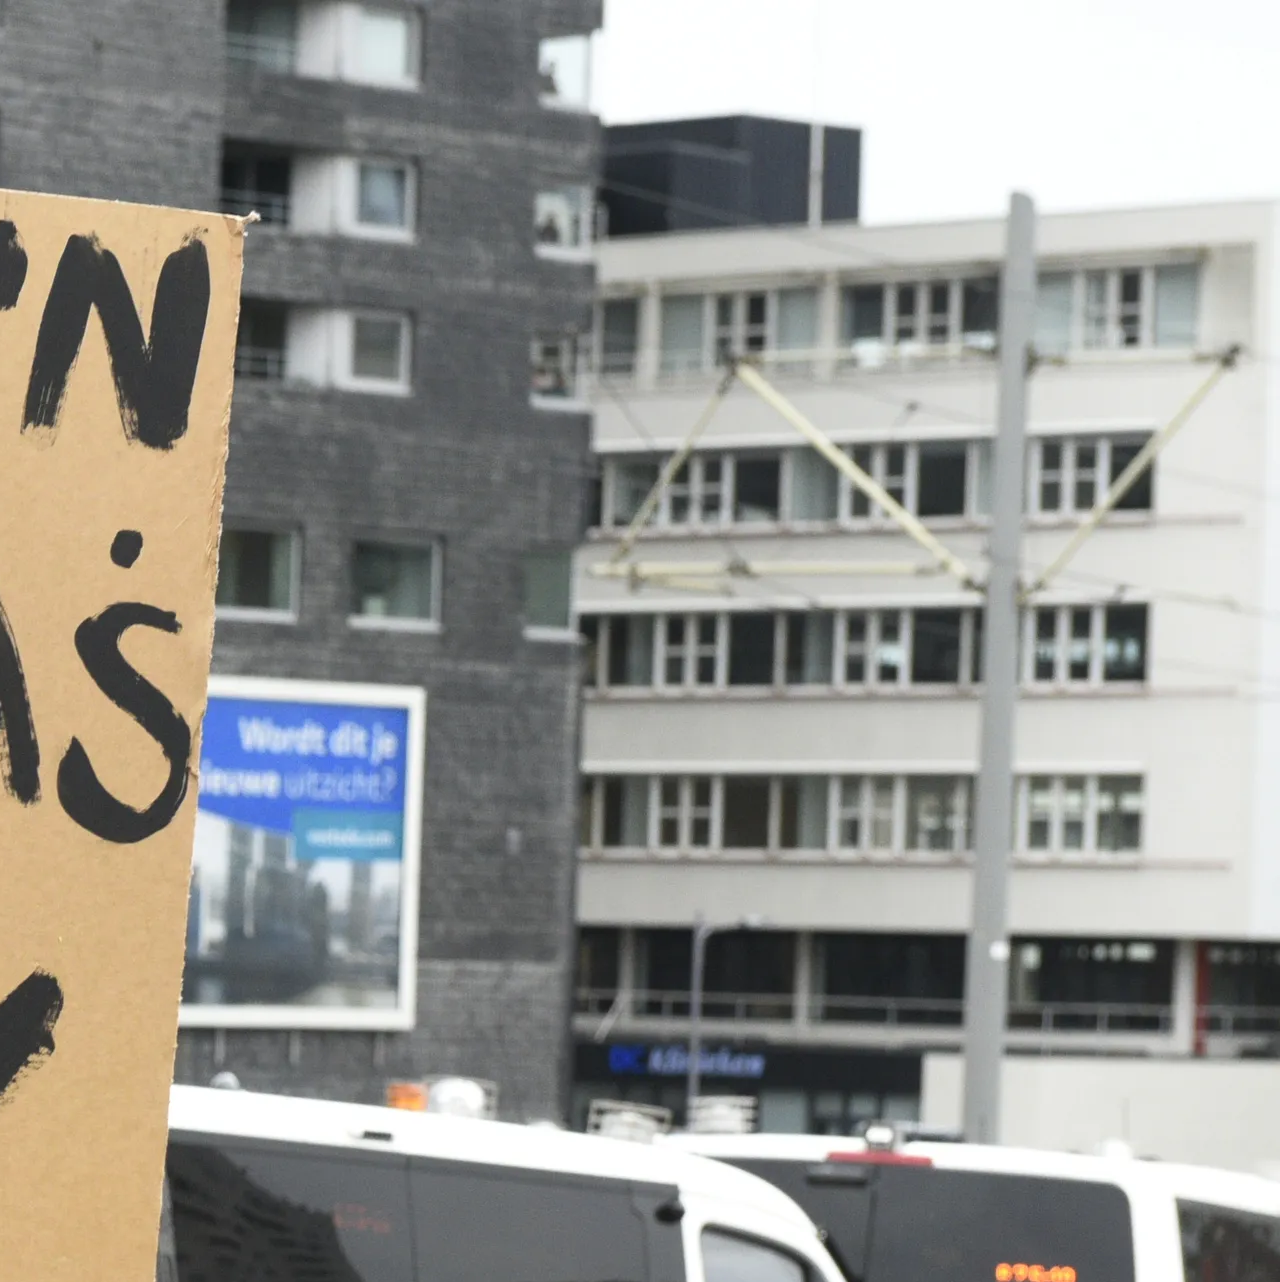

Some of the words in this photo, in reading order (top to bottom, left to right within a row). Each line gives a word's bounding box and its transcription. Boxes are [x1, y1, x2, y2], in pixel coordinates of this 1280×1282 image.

[237, 716, 327, 756] Wordt
[329, 720, 369, 758] dit
[369, 722, 399, 767] je
[199, 758, 281, 799] ieuwe
